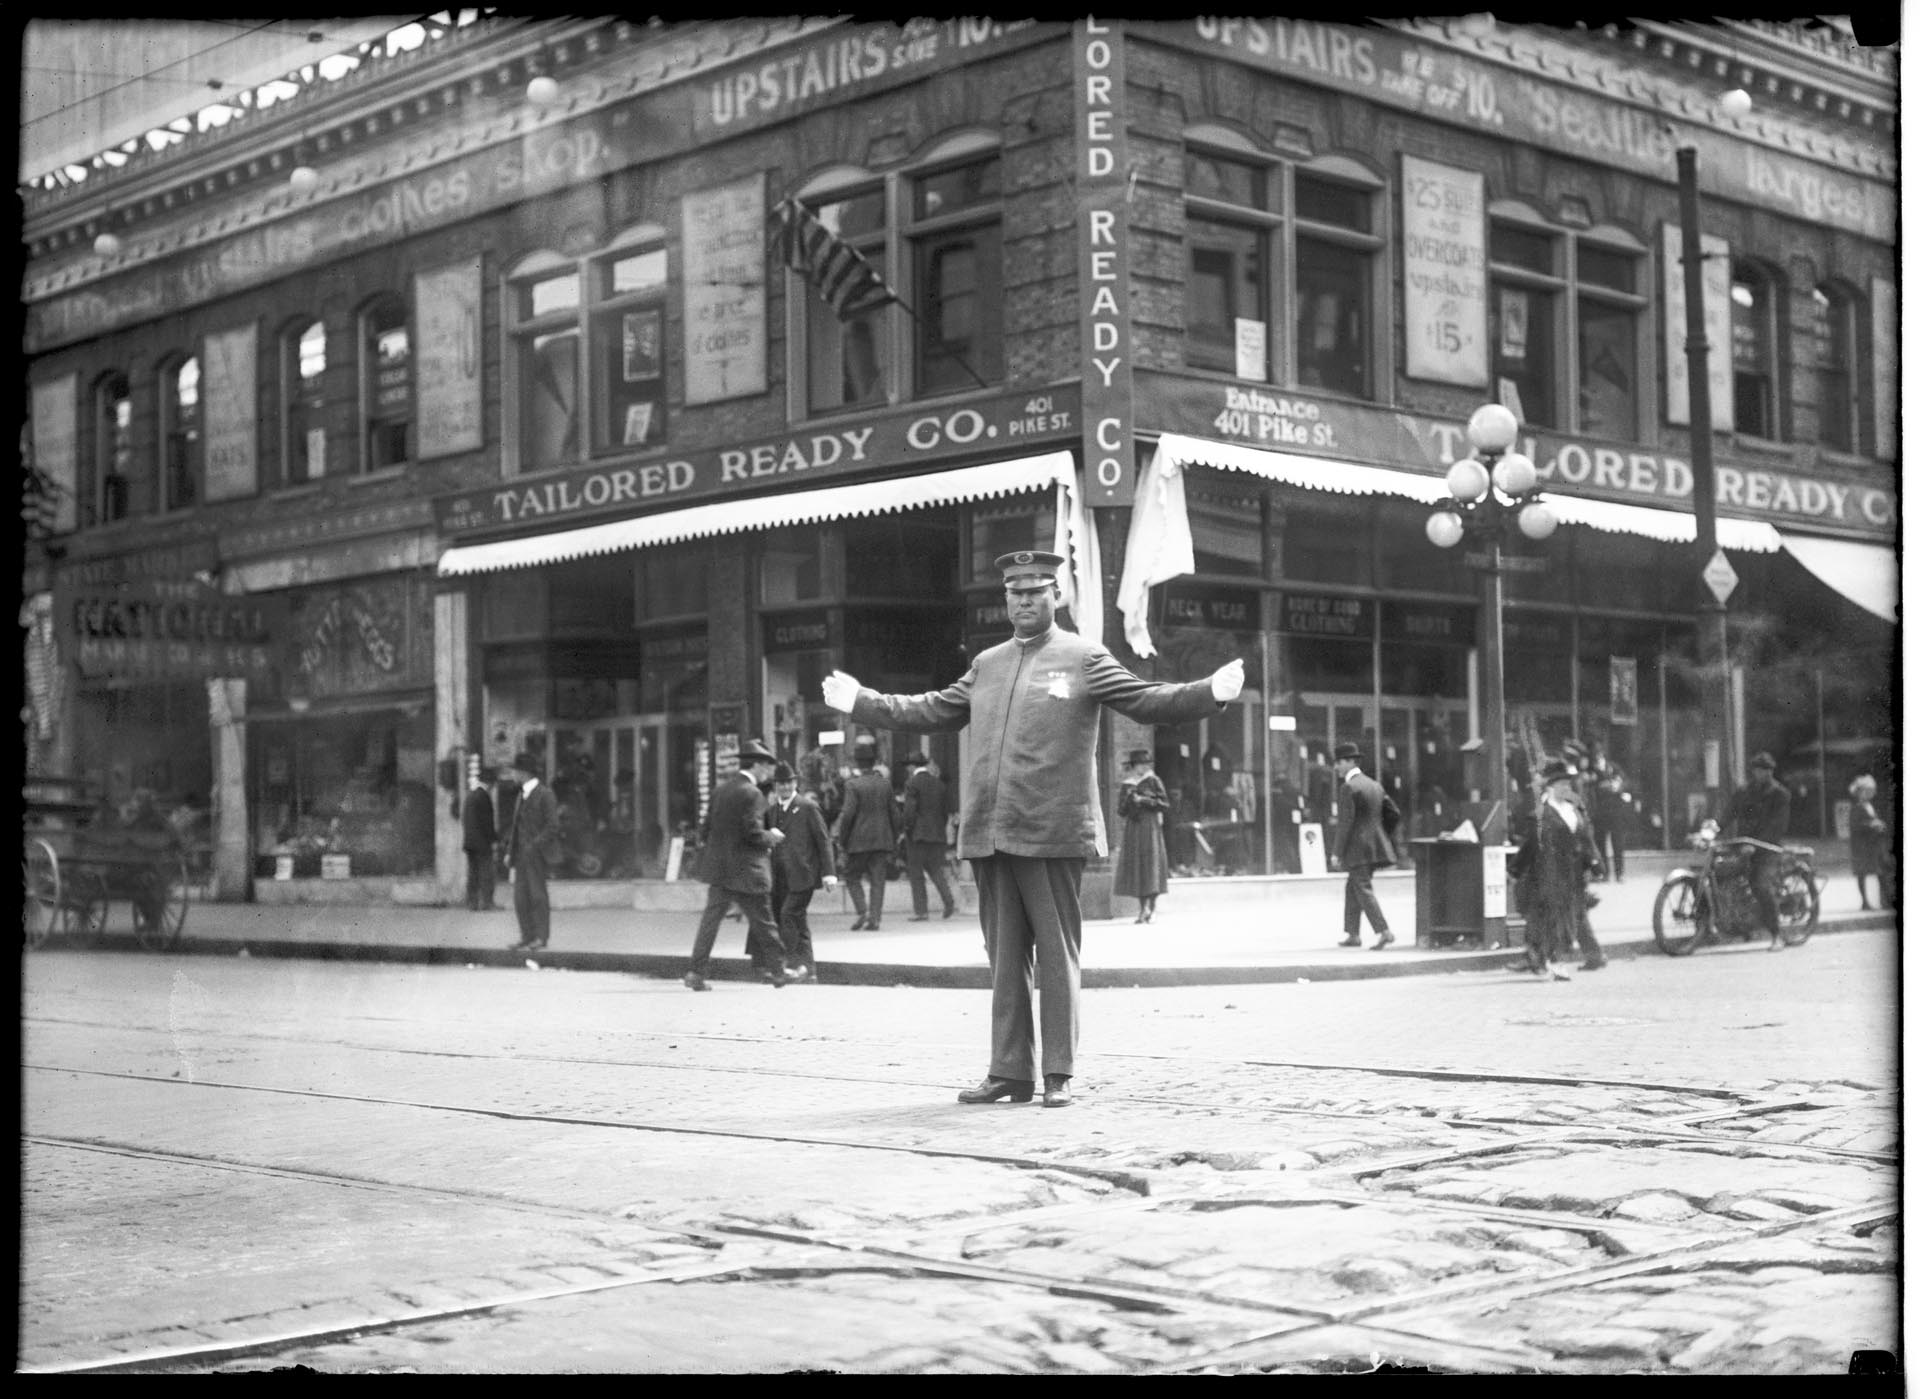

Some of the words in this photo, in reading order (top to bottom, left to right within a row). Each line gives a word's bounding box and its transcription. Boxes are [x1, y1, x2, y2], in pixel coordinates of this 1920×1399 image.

[711, 27, 888, 125] UPSTAIRS
[1088, 209, 1123, 388] READY
[1009, 416, 1047, 436] PIKE
[1025, 396, 1053, 413] 401
[1214, 408, 1250, 437] 401
[1257, 414, 1309, 444] Pike
[1225, 386, 1320, 421] Entrance
[494, 461, 696, 521] TAILORED
[719, 427, 874, 482] READY
[906, 409, 997, 450] CO.
[1429, 424, 1695, 497] TLORED
[1713, 467, 1852, 519] READY
[1860, 488, 1896, 525] C
